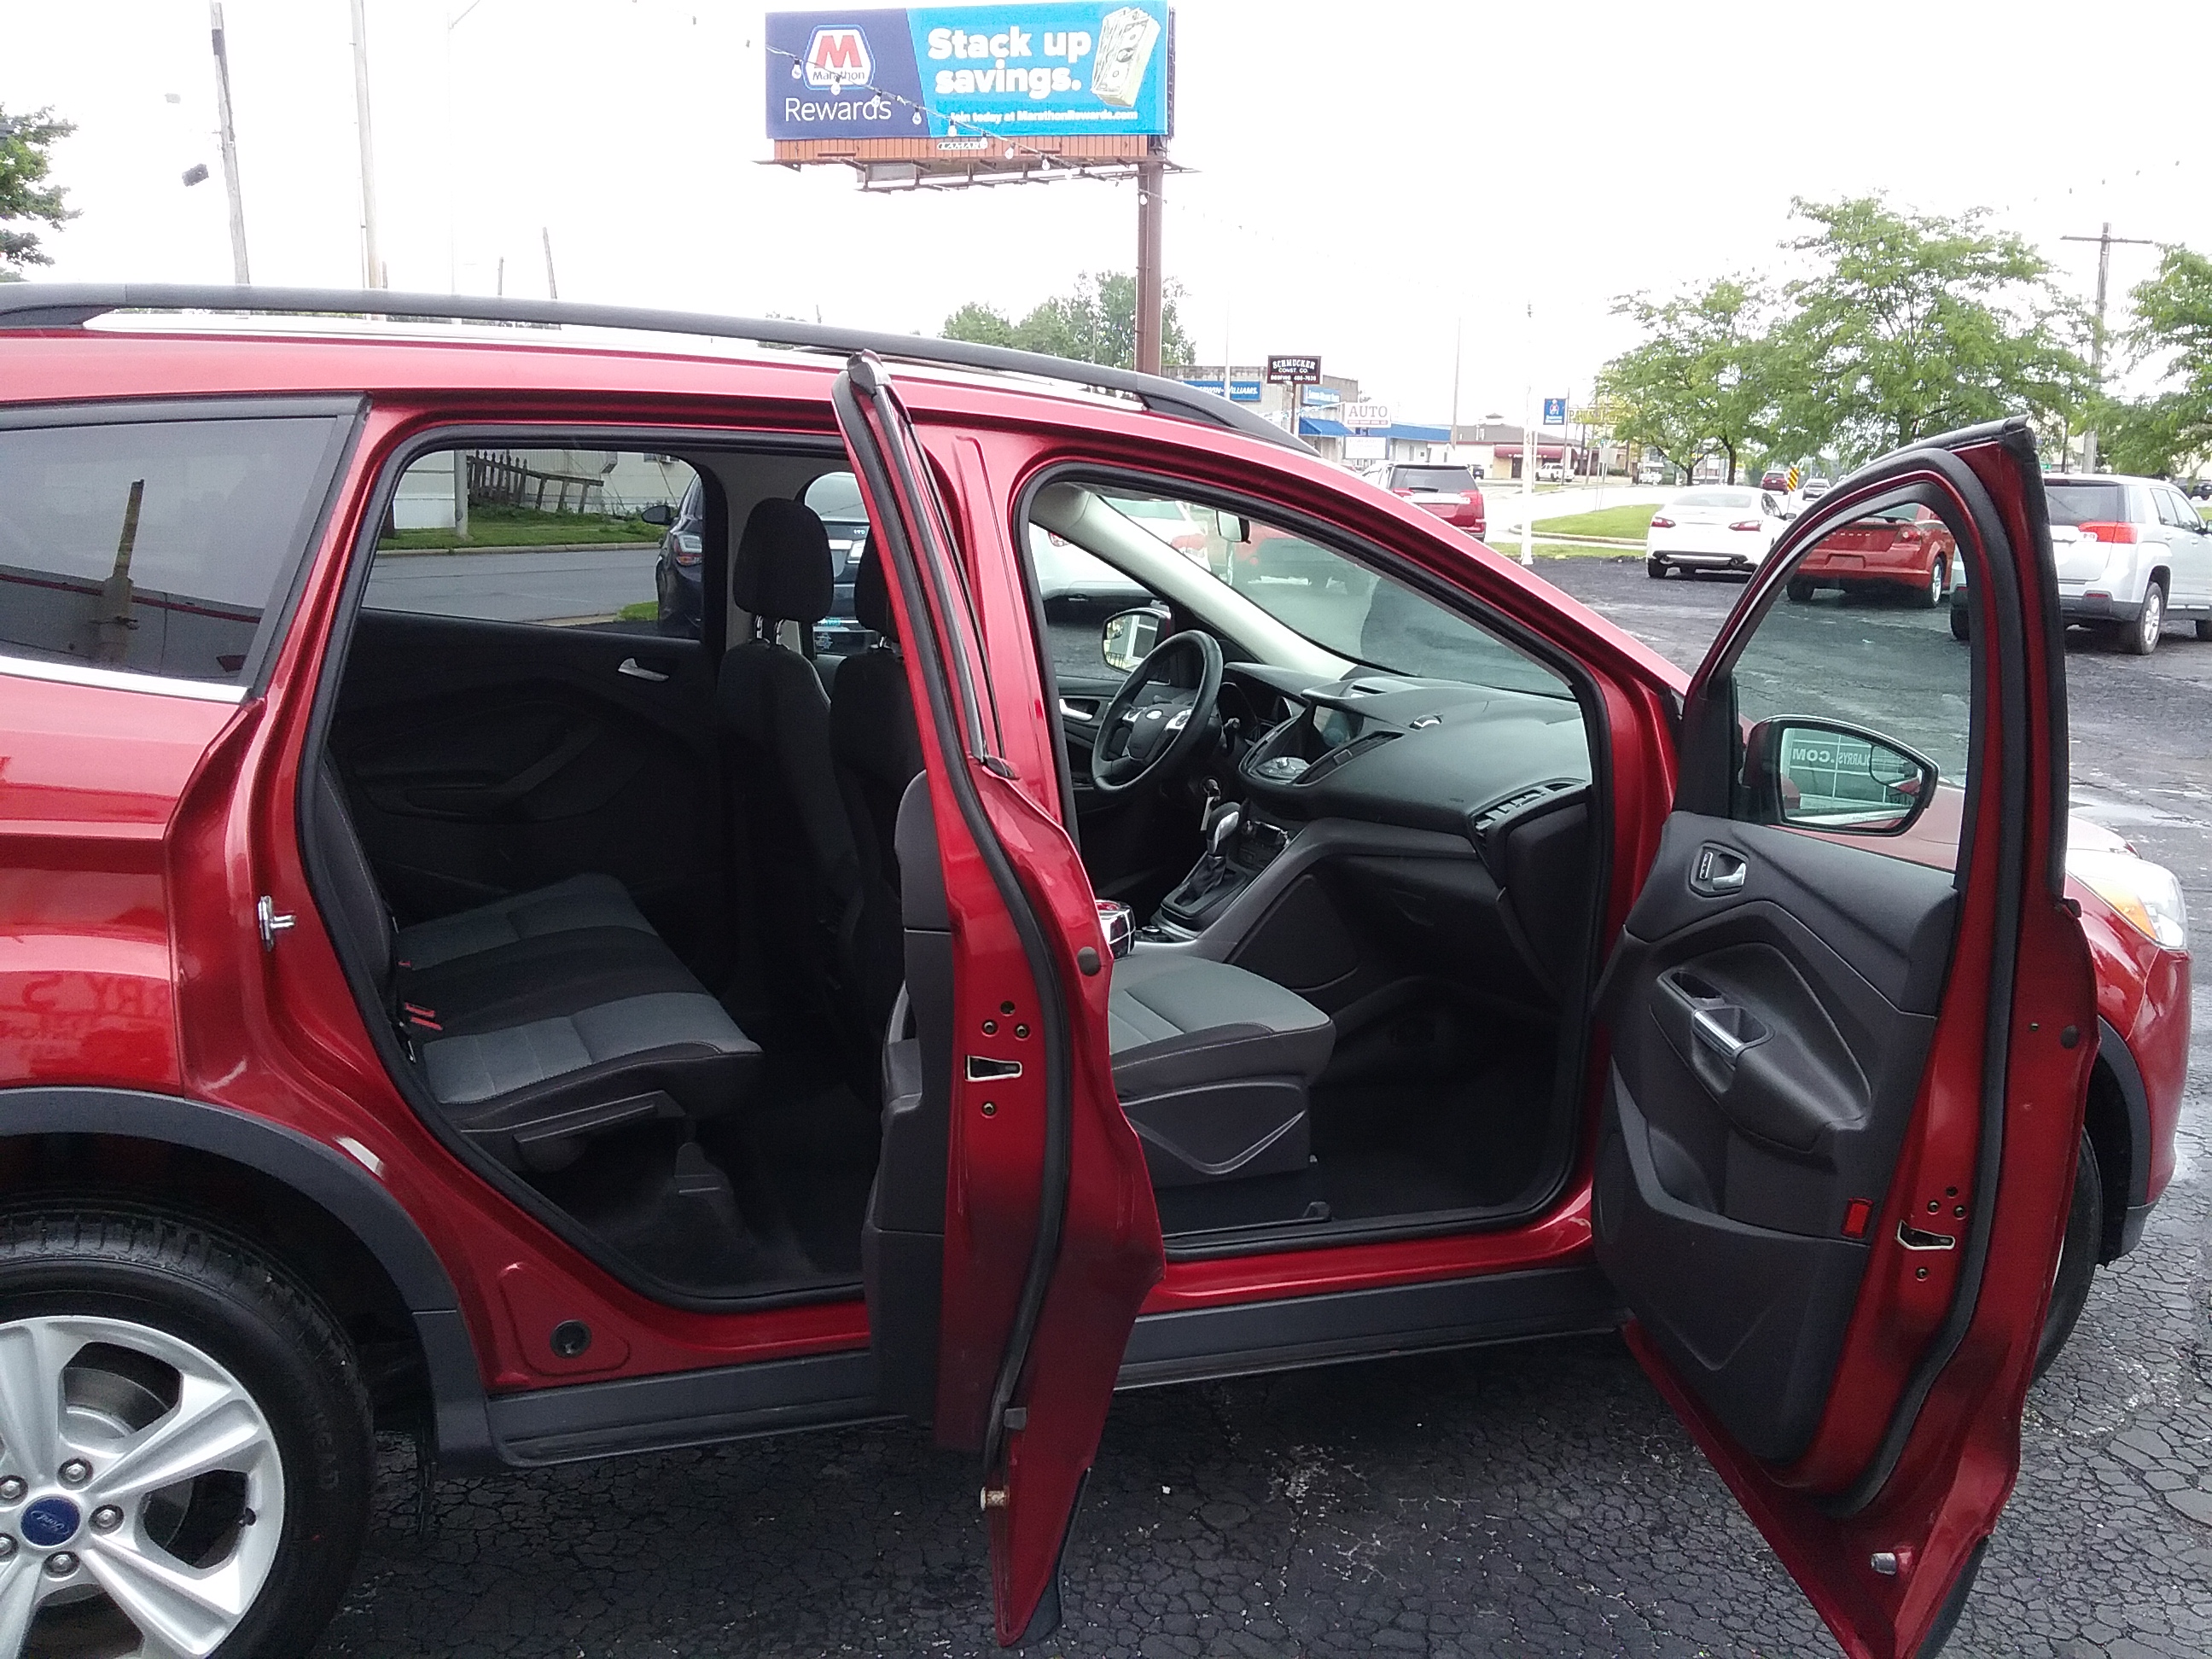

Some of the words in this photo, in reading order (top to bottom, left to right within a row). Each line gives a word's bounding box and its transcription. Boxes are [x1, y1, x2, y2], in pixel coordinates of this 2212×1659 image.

[814, 35, 863, 68] M
[928, 26, 1033, 59] Stack
[1044, 32, 1091, 63] up
[812, 71, 864, 81] Marathon
[935, 58, 1081, 99] savings.
[785, 97, 892, 121] Rewards
[973, 111, 1002, 124] today
[1004, 111, 1015, 121] at
[1016, 110, 1138, 120] MarathonRewards.com
[1272, 359, 1315, 370] SCHMUCKER
[1349, 405, 1388, 417] AUTO
